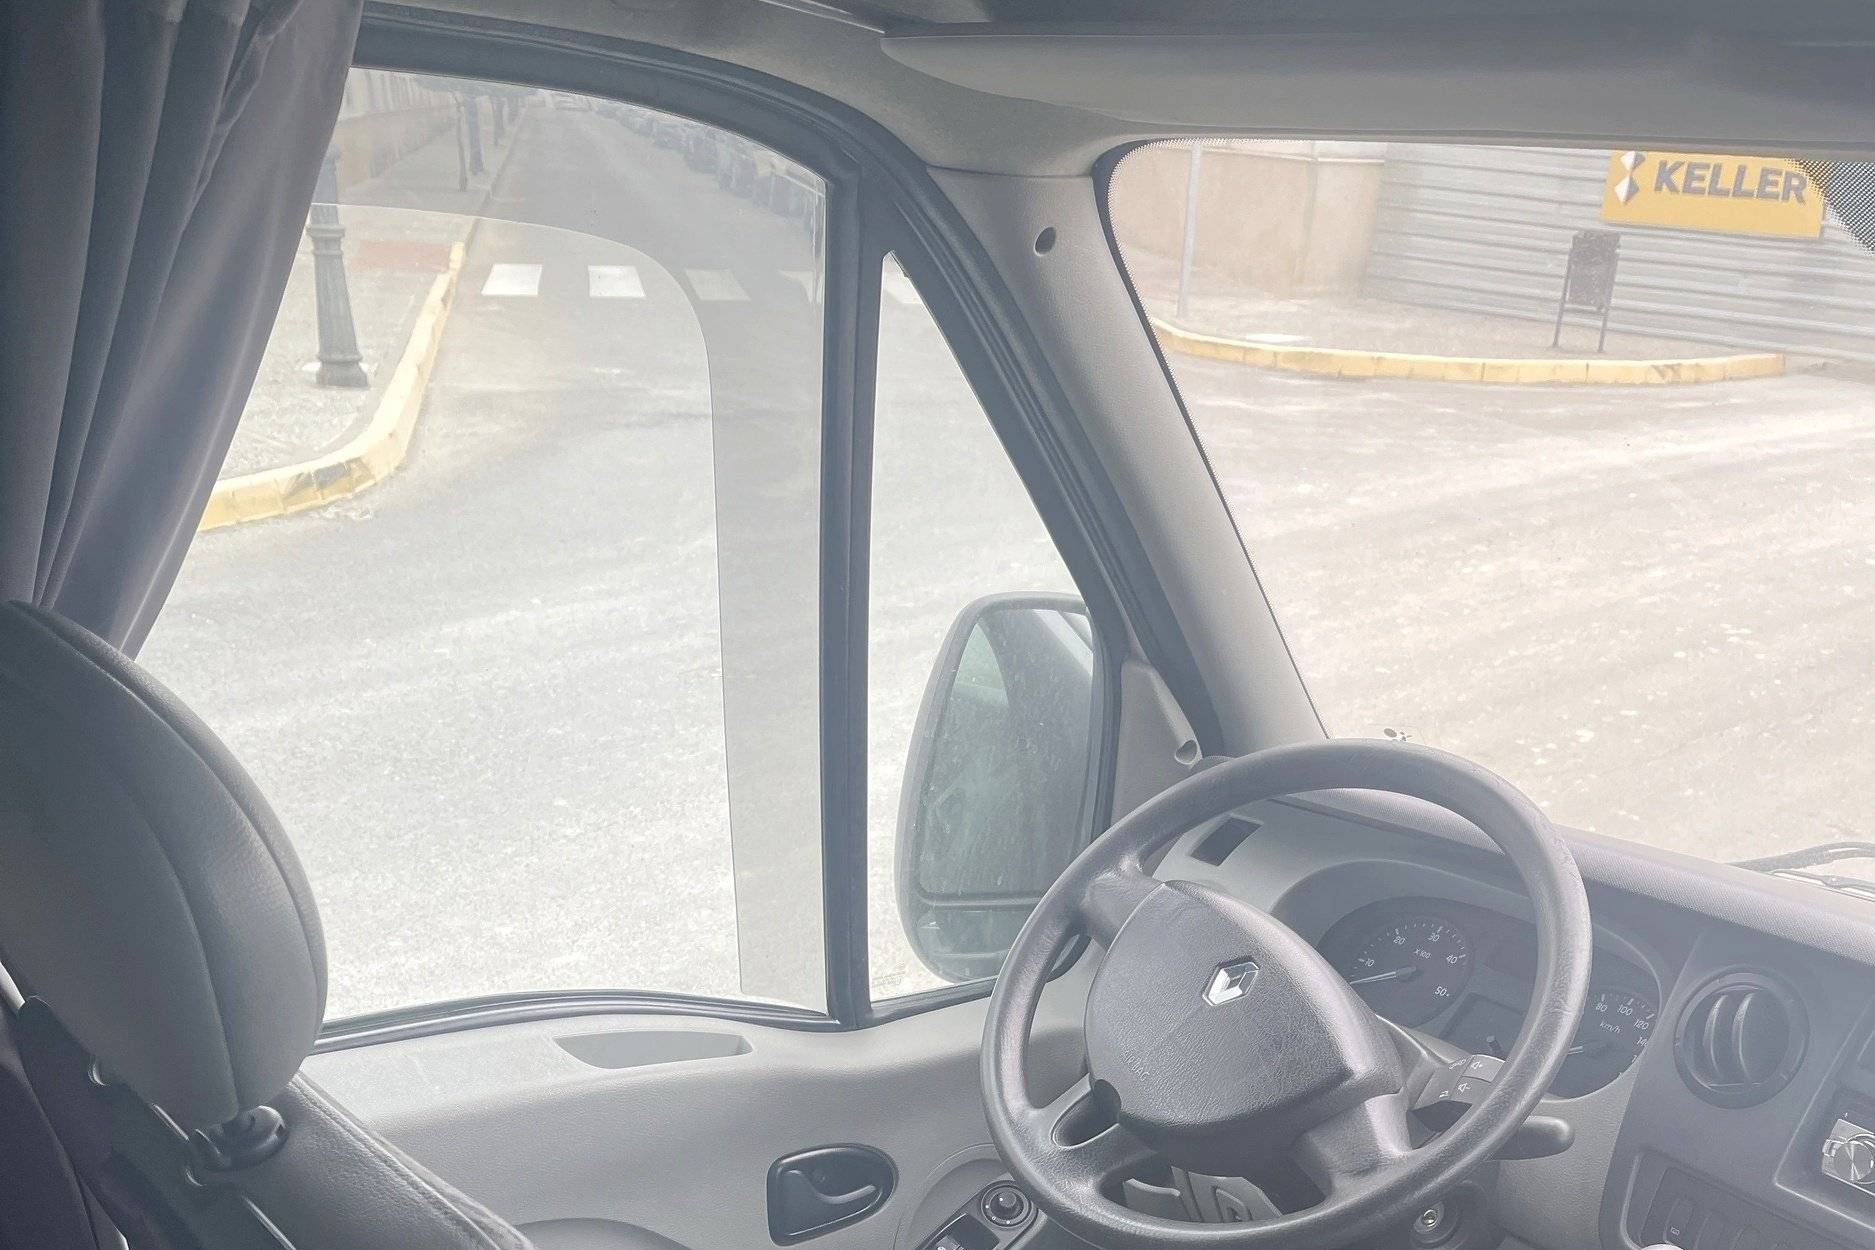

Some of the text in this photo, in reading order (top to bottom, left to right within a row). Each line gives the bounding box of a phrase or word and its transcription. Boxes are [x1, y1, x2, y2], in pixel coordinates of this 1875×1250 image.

[1654, 160, 1807, 205] KELLER
[1617, 1004, 1633, 1016] 100
[1600, 1021, 1621, 1033] km/h
